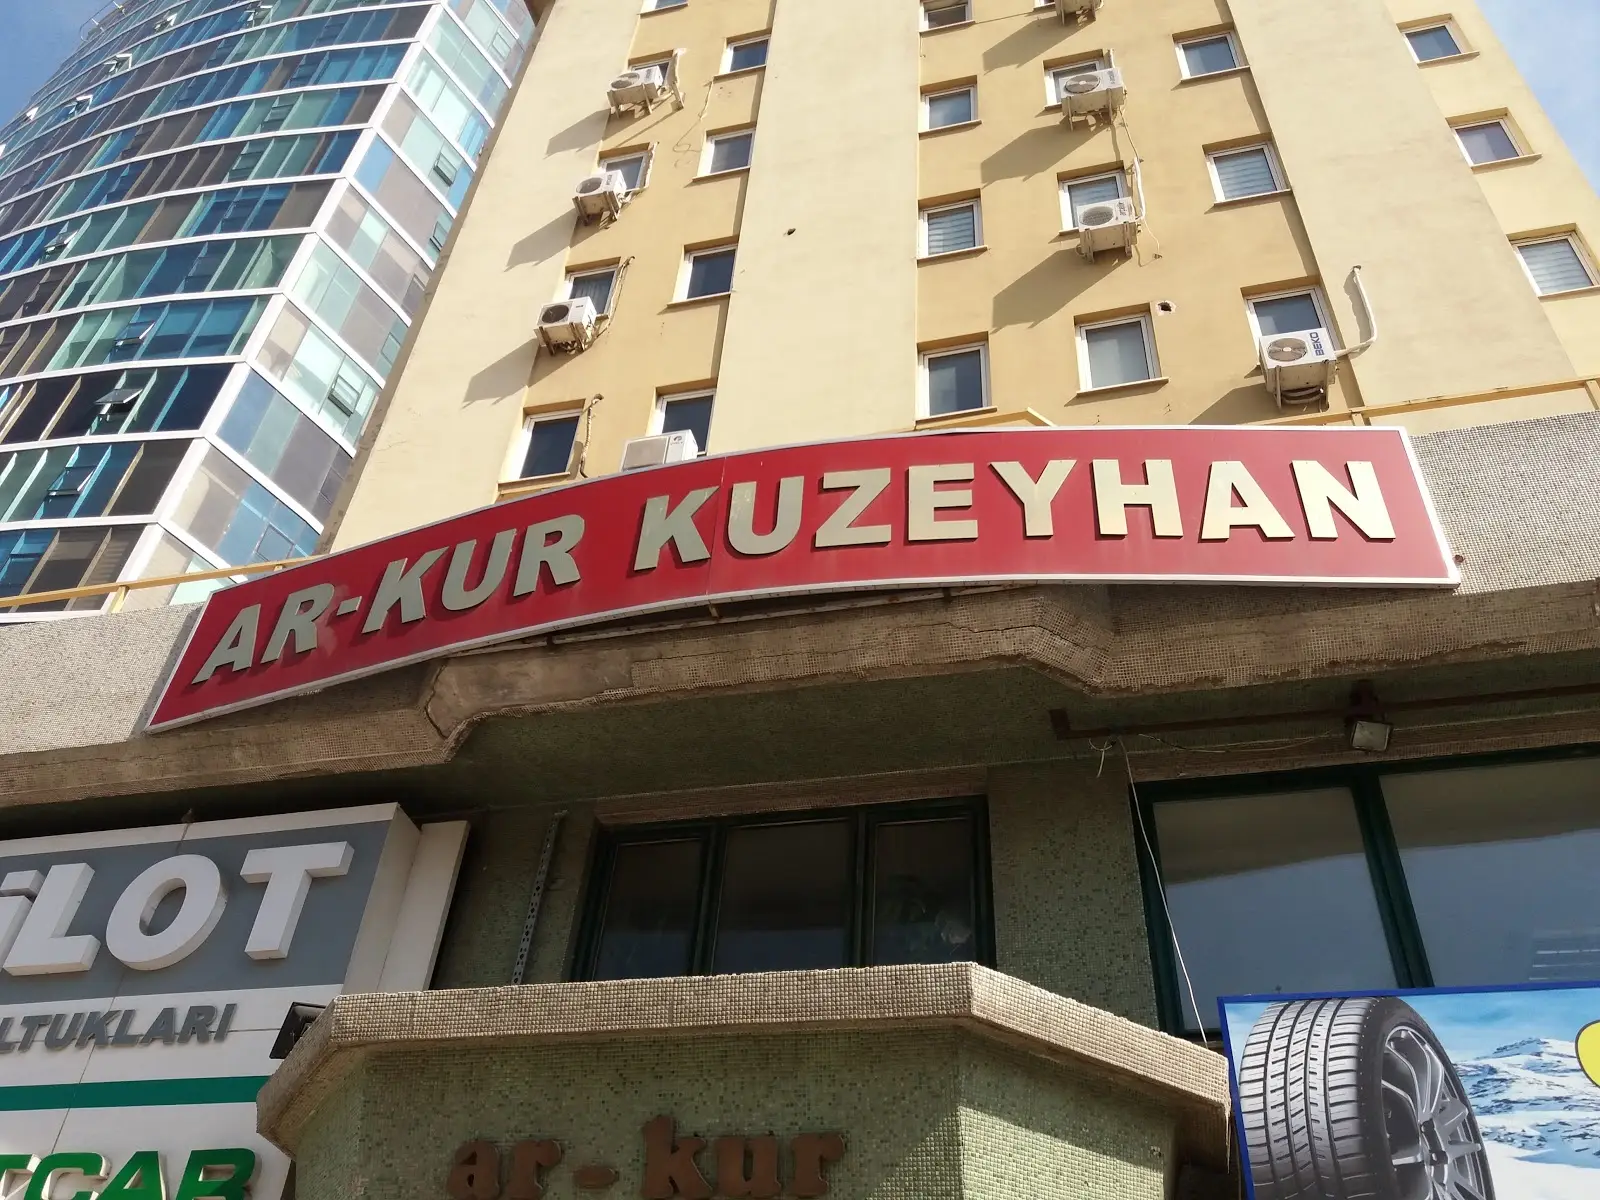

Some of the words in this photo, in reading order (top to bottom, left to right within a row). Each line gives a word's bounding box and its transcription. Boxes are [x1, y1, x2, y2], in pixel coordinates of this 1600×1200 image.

[1309, 331, 1325, 356] BEKO
[191, 513, 586, 686] AR-KUR
[632, 458, 1397, 573] KUZEYHAN
